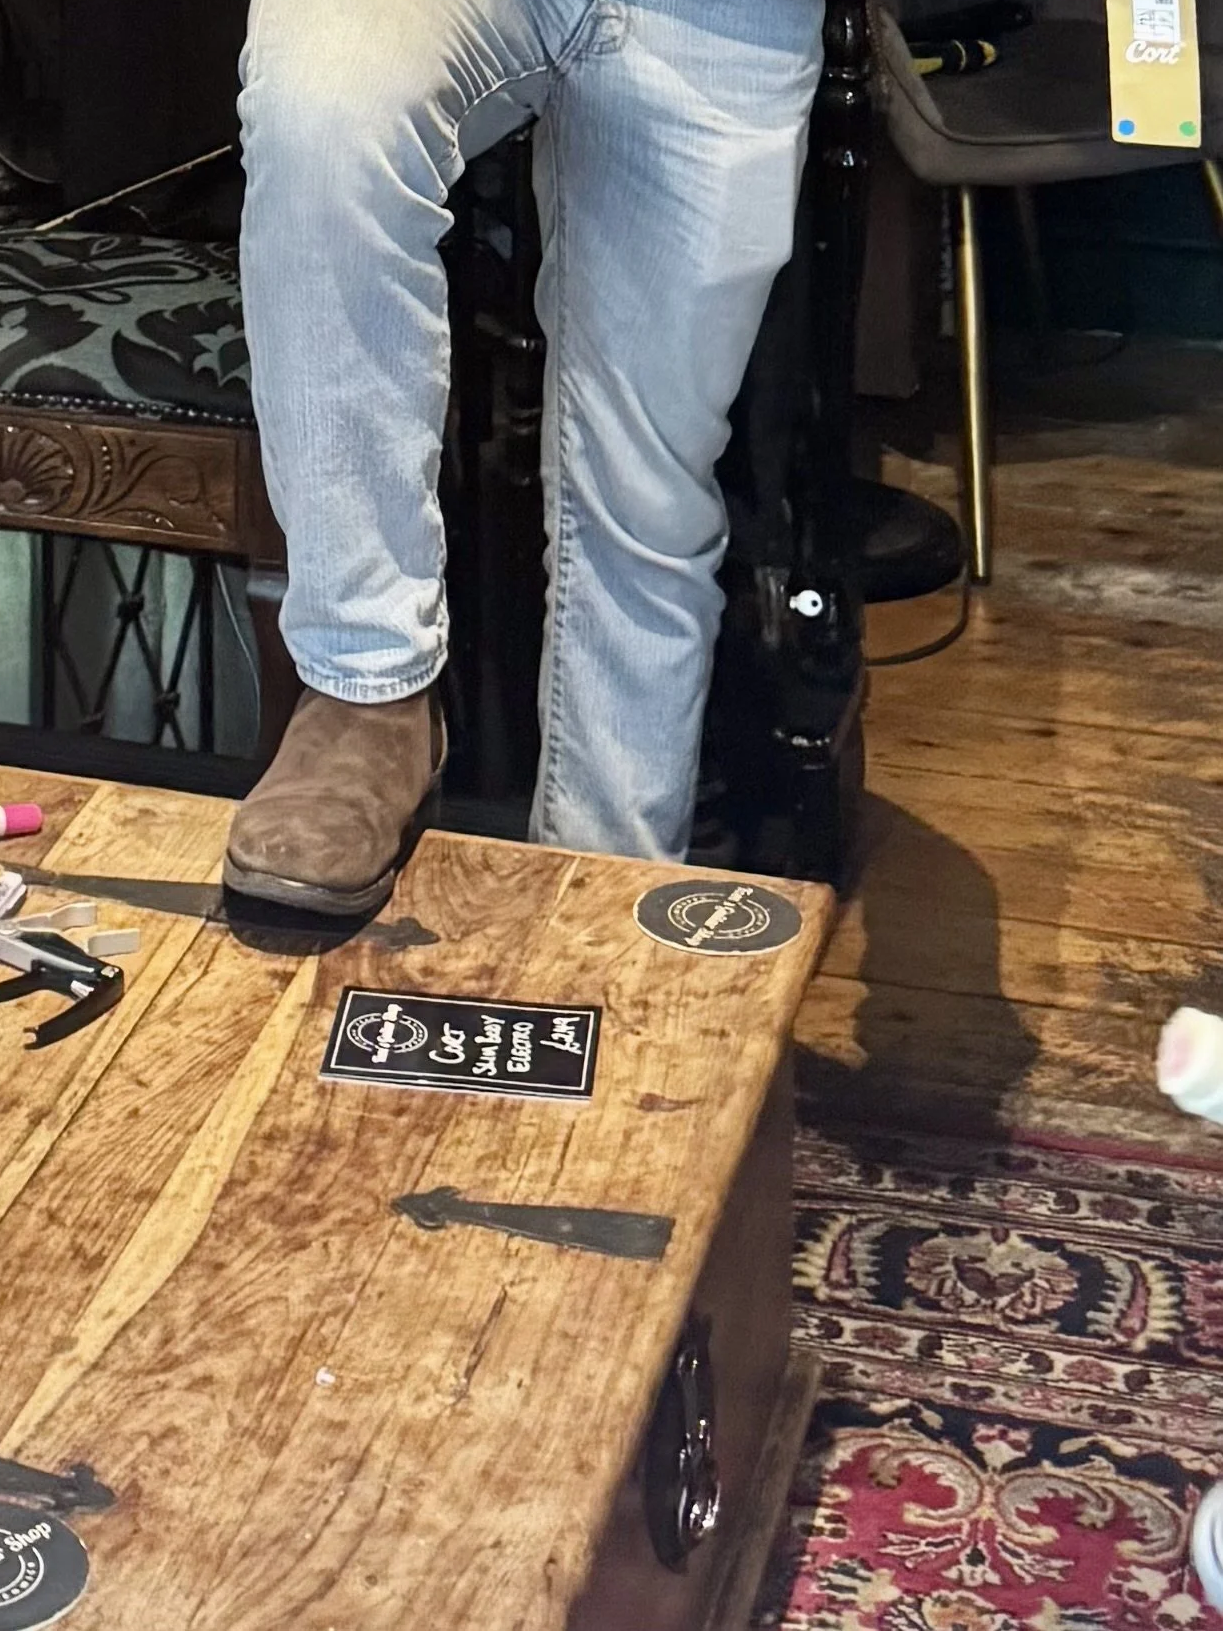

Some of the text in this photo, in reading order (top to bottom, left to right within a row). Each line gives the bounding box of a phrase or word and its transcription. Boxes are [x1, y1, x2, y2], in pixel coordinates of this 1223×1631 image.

[1125, 40, 1180, 65] Cort
[472, 1014, 505, 1076] SLIM BODY
[507, 1021, 534, 1073] ELECTRO
[540, 1016, 583, 1055] £249
[4, 1521, 52, 1552] Shop
